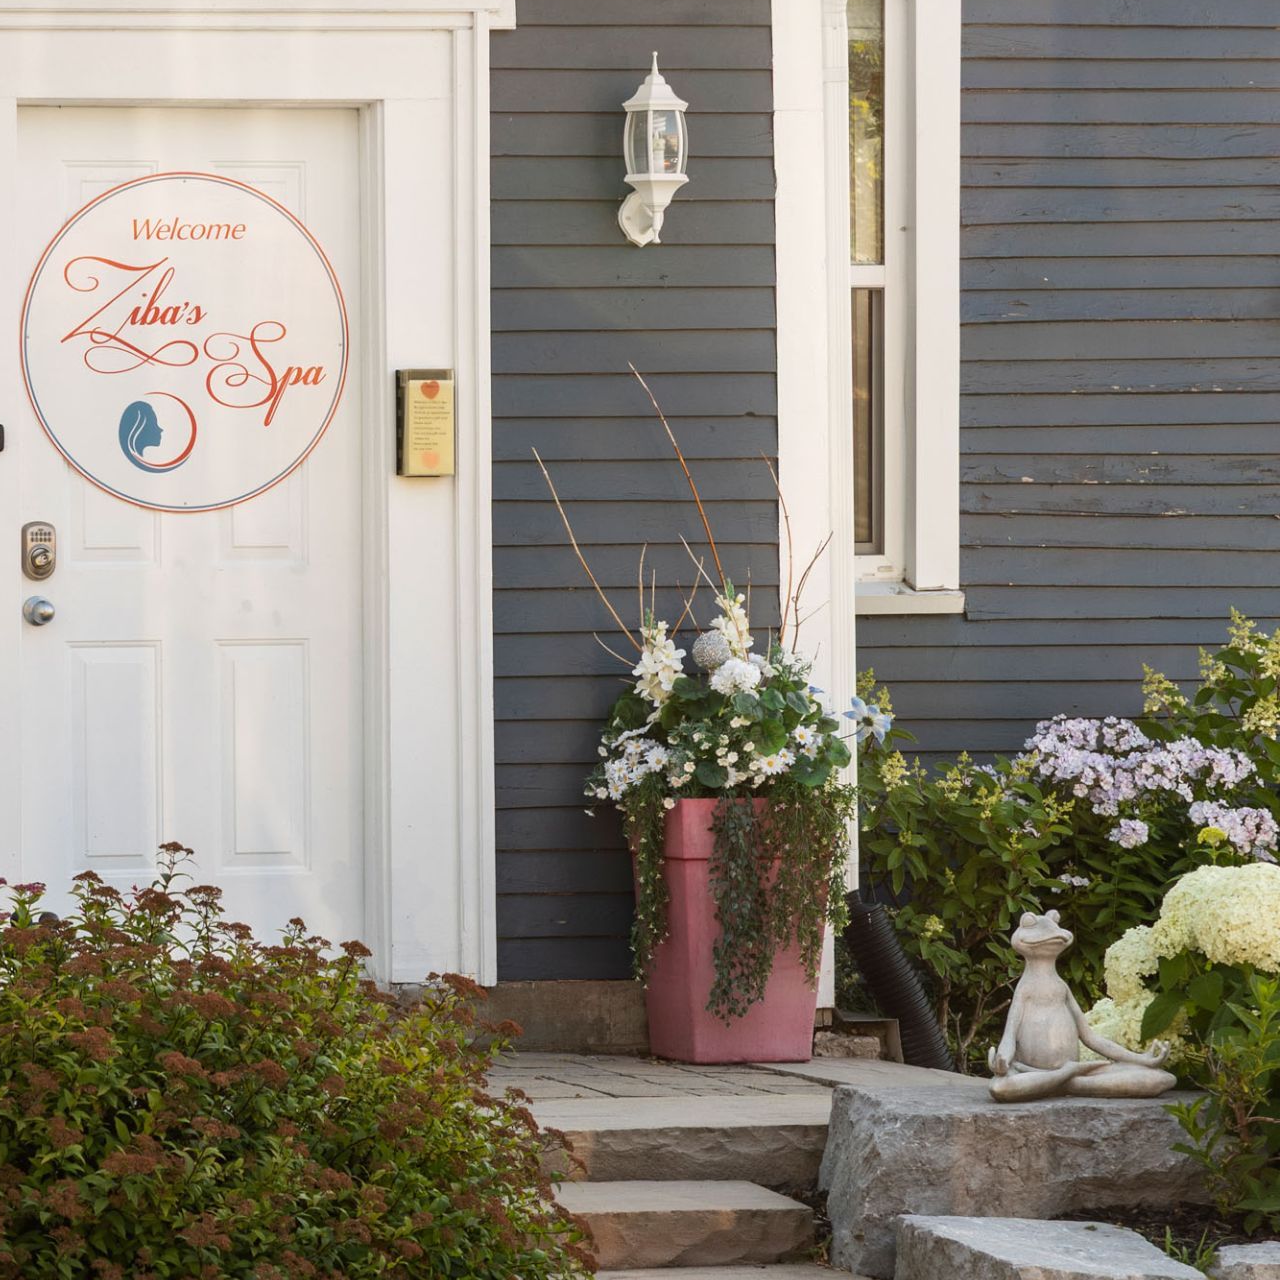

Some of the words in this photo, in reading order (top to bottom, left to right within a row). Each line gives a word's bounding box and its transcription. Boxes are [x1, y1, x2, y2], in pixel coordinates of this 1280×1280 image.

[131, 217, 247, 241] Welcome
[61, 256, 208, 374] Ziba's
[204, 321, 327, 426] Spa
